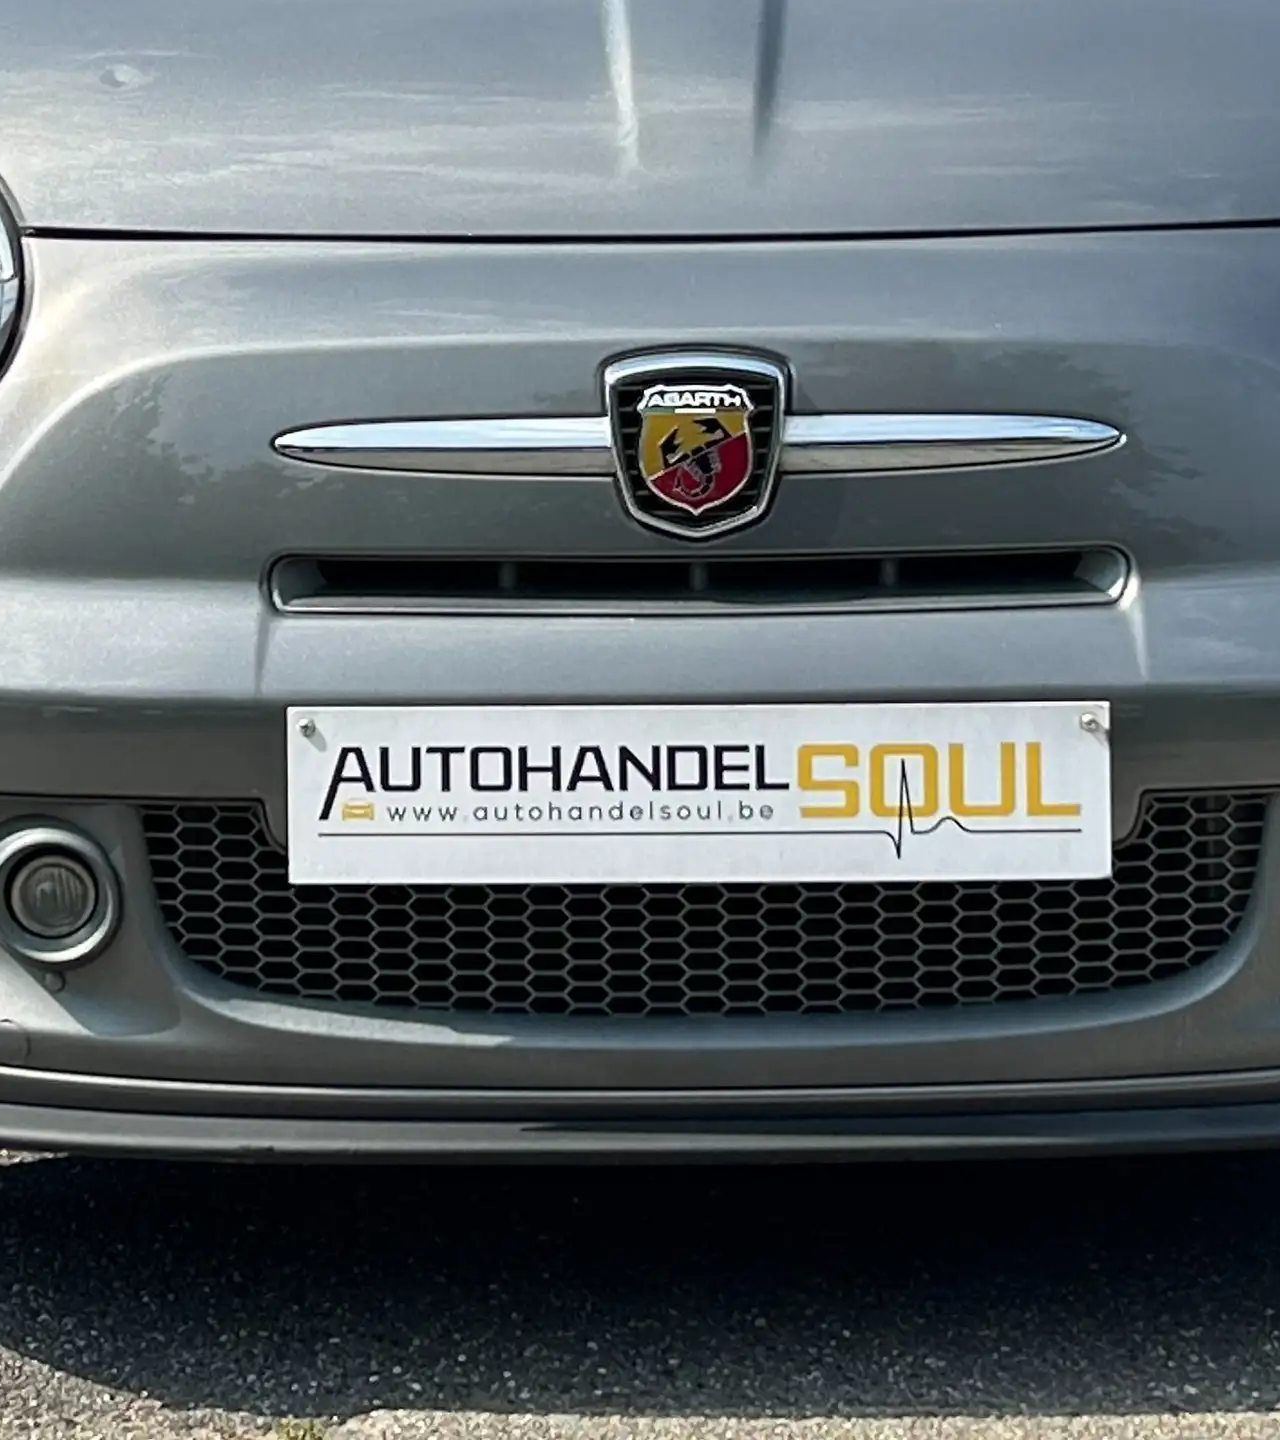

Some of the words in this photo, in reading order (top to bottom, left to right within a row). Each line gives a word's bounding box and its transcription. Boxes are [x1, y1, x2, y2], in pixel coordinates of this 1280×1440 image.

[647, 391, 742, 407] ABARTH
[318, 744, 790, 821] AUTOHANDEL
[797, 741, 1082, 819] SOUL
[386, 800, 775, 823] www.autohandelsoul.be
